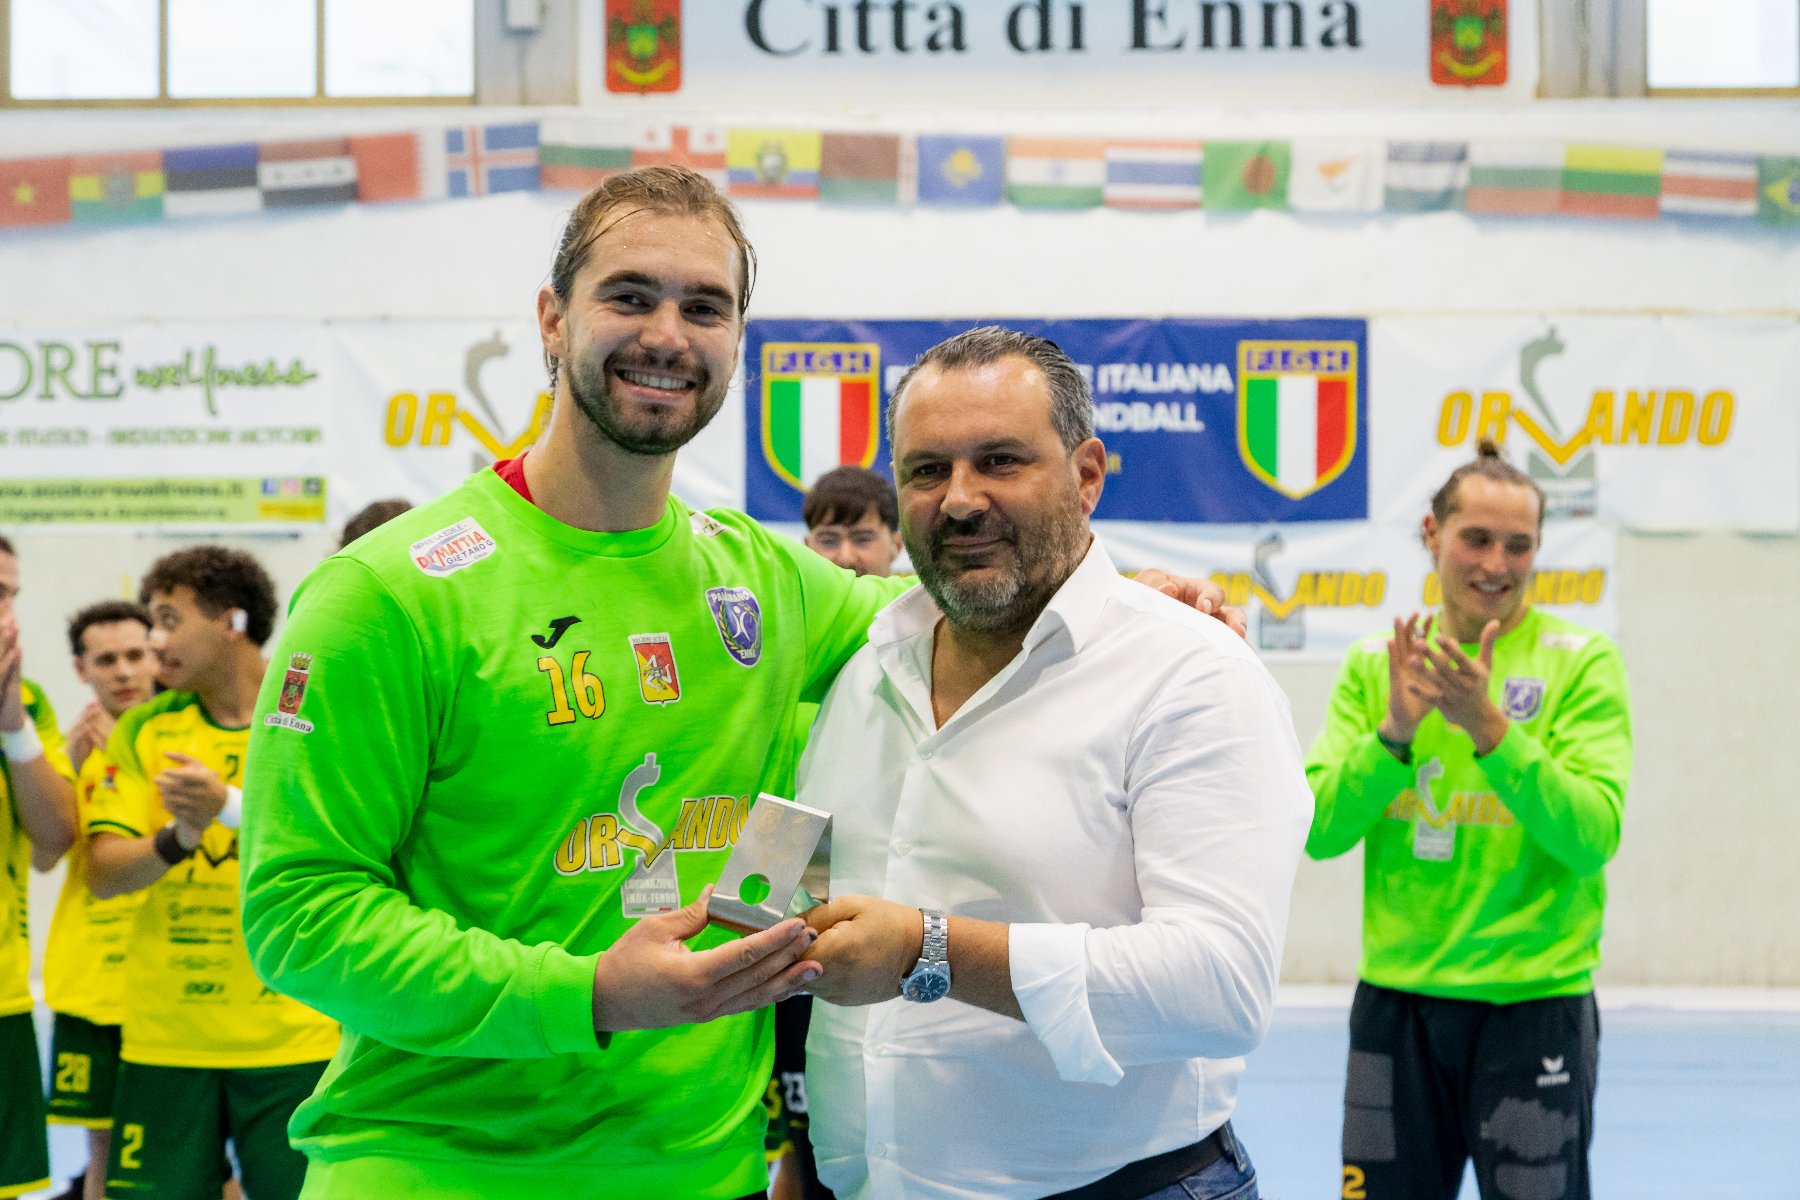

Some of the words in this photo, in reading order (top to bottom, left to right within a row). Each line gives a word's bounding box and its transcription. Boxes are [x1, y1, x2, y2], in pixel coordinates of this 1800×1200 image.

[1006, 0, 1086, 53] di
[1122, 0, 1362, 51] Enna
[1097, 363, 1235, 394] ITALIANA
[1093, 402, 1204, 432] NDBALL
[434, 531, 486, 568] MATTIA
[538, 650, 606, 726] 16
[120, 1124, 144, 1169] 2
